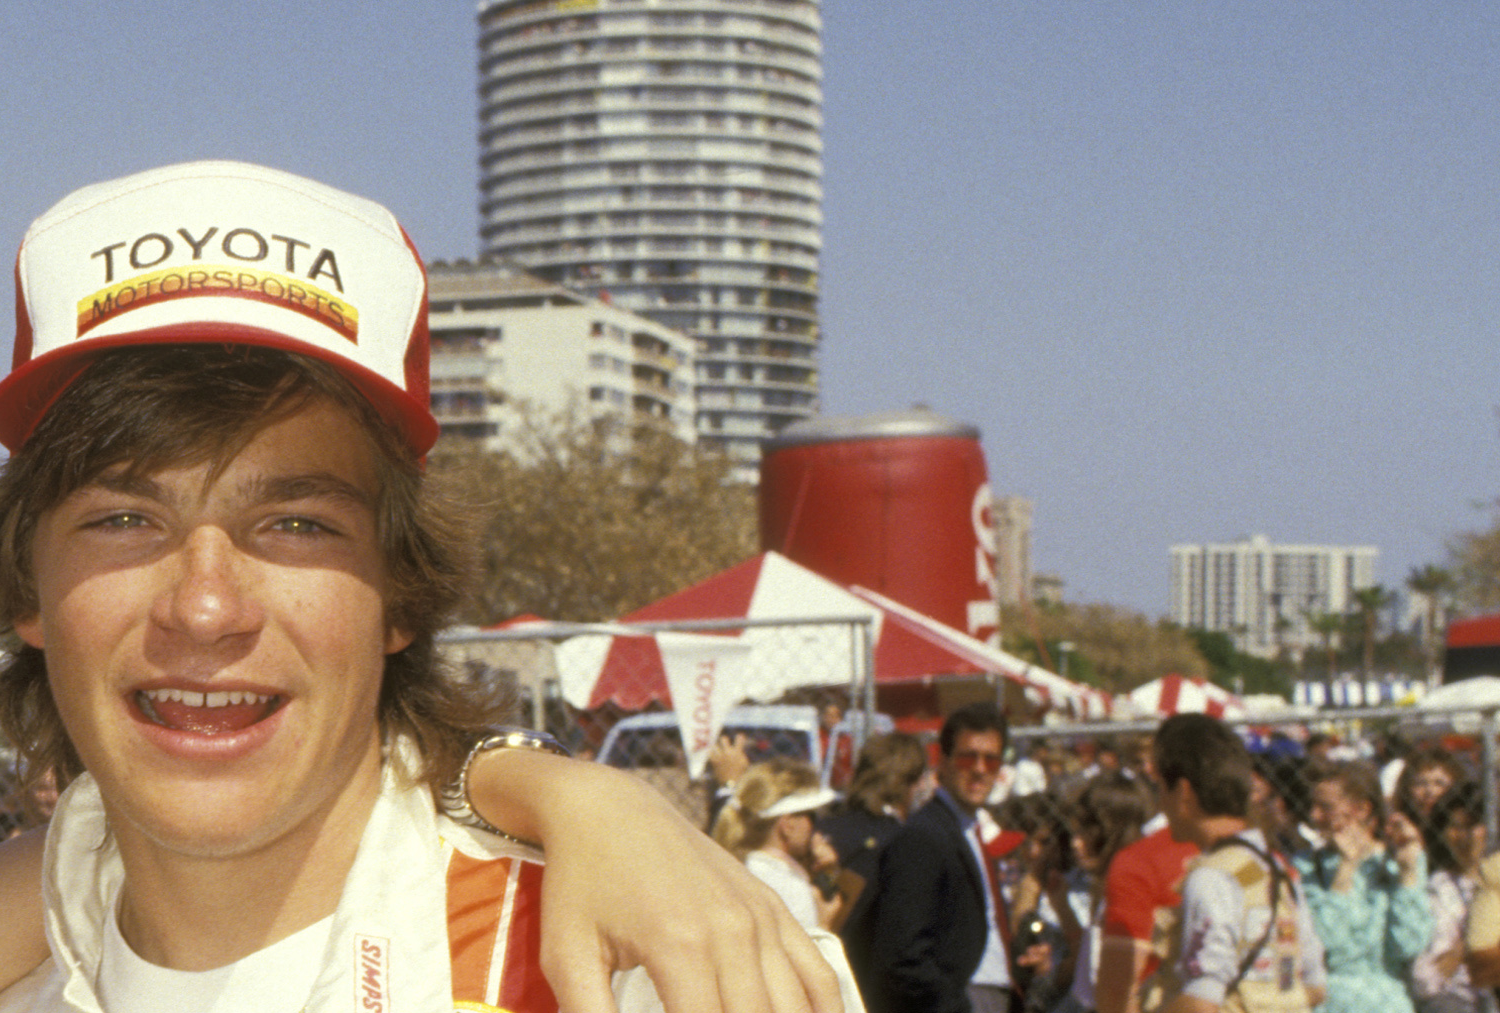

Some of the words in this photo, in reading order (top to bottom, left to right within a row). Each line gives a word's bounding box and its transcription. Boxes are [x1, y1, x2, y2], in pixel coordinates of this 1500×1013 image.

[91, 227, 344, 294] TOYOTA
[92, 271, 345, 328] MOTORSPORTS
[693, 659, 717, 753] TOYOTA
